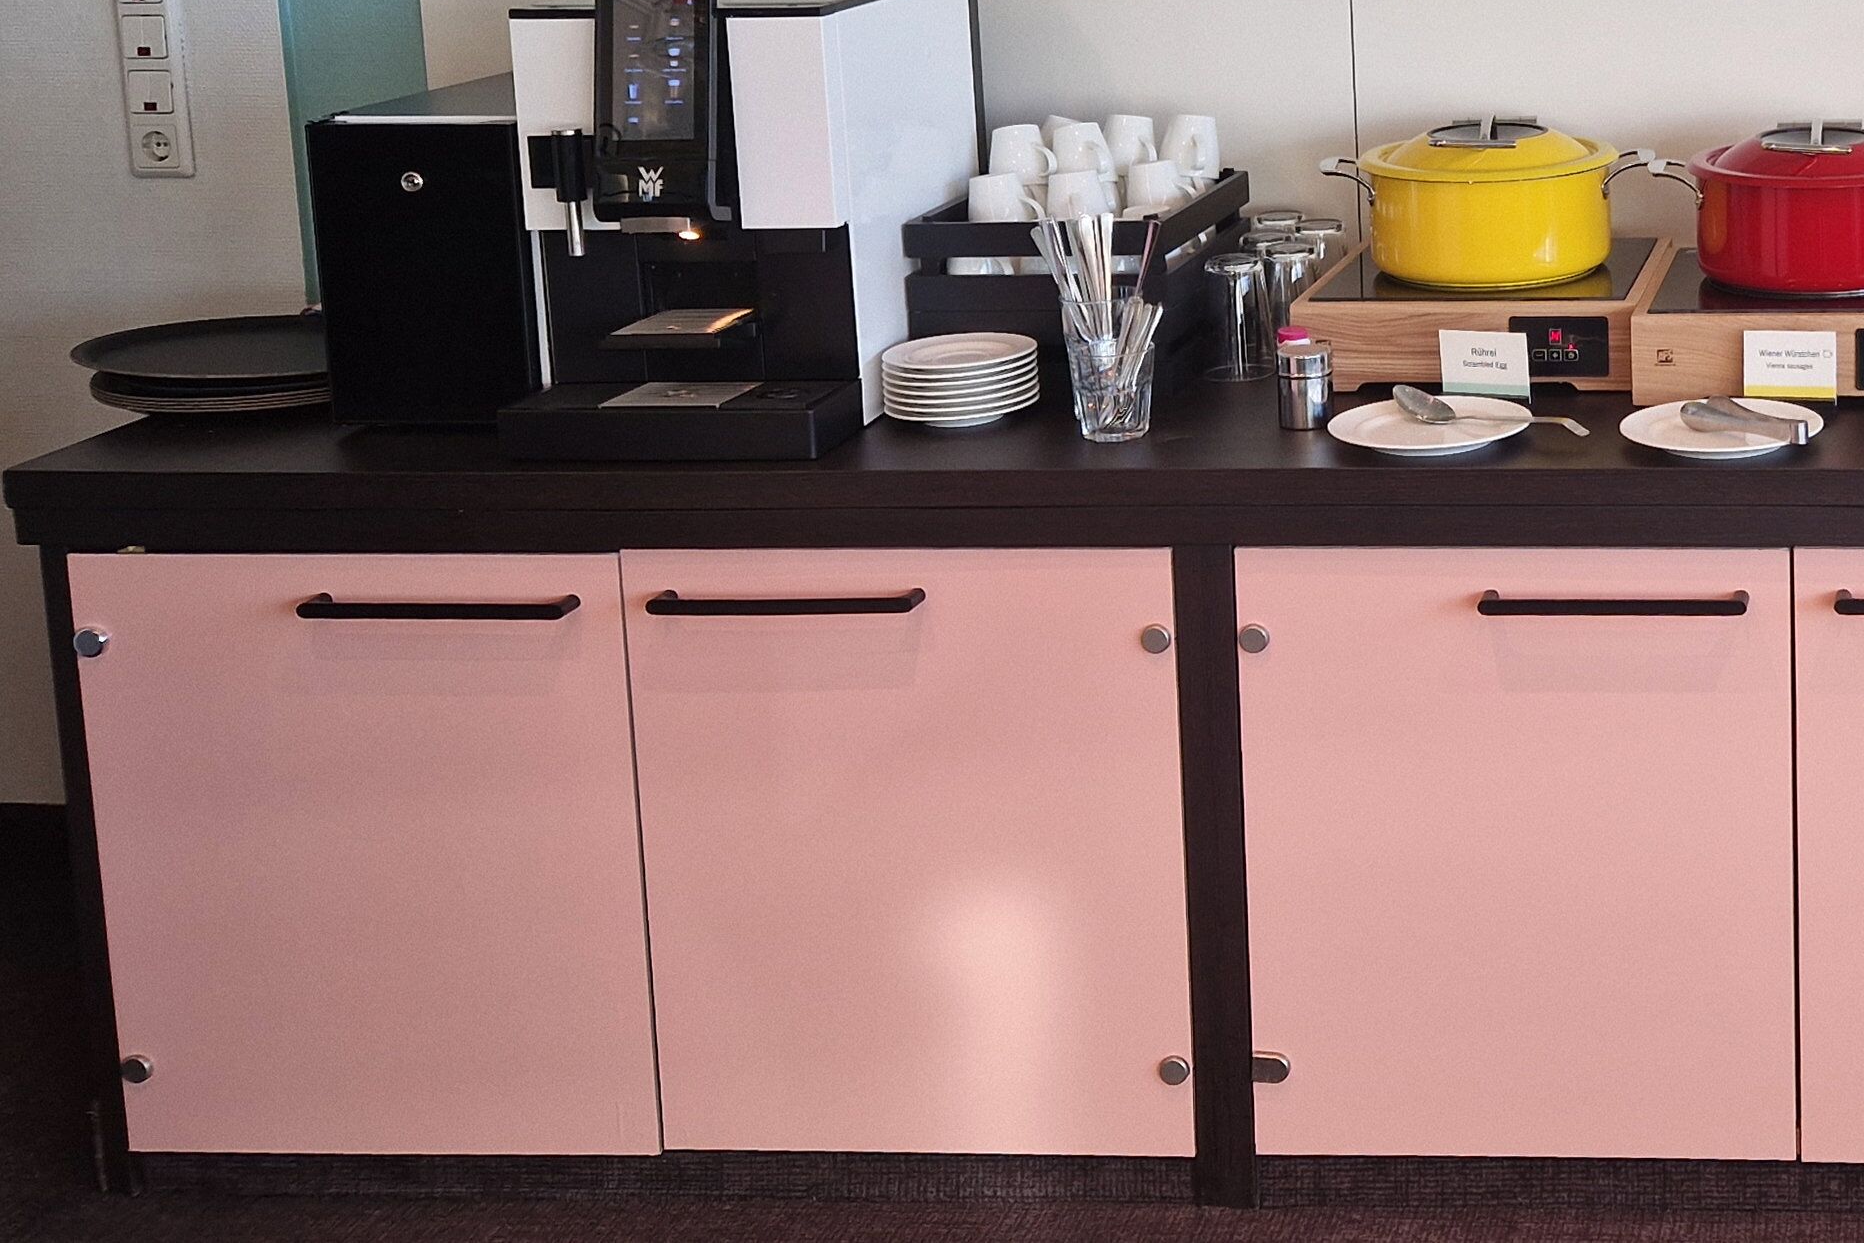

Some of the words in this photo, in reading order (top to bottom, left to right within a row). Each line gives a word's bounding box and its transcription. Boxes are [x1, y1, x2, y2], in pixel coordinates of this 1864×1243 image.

[638, 166, 664, 198] WMF
[1470, 347, 1497, 357] Rührei
[1759, 349, 1783, 357] Wiener
